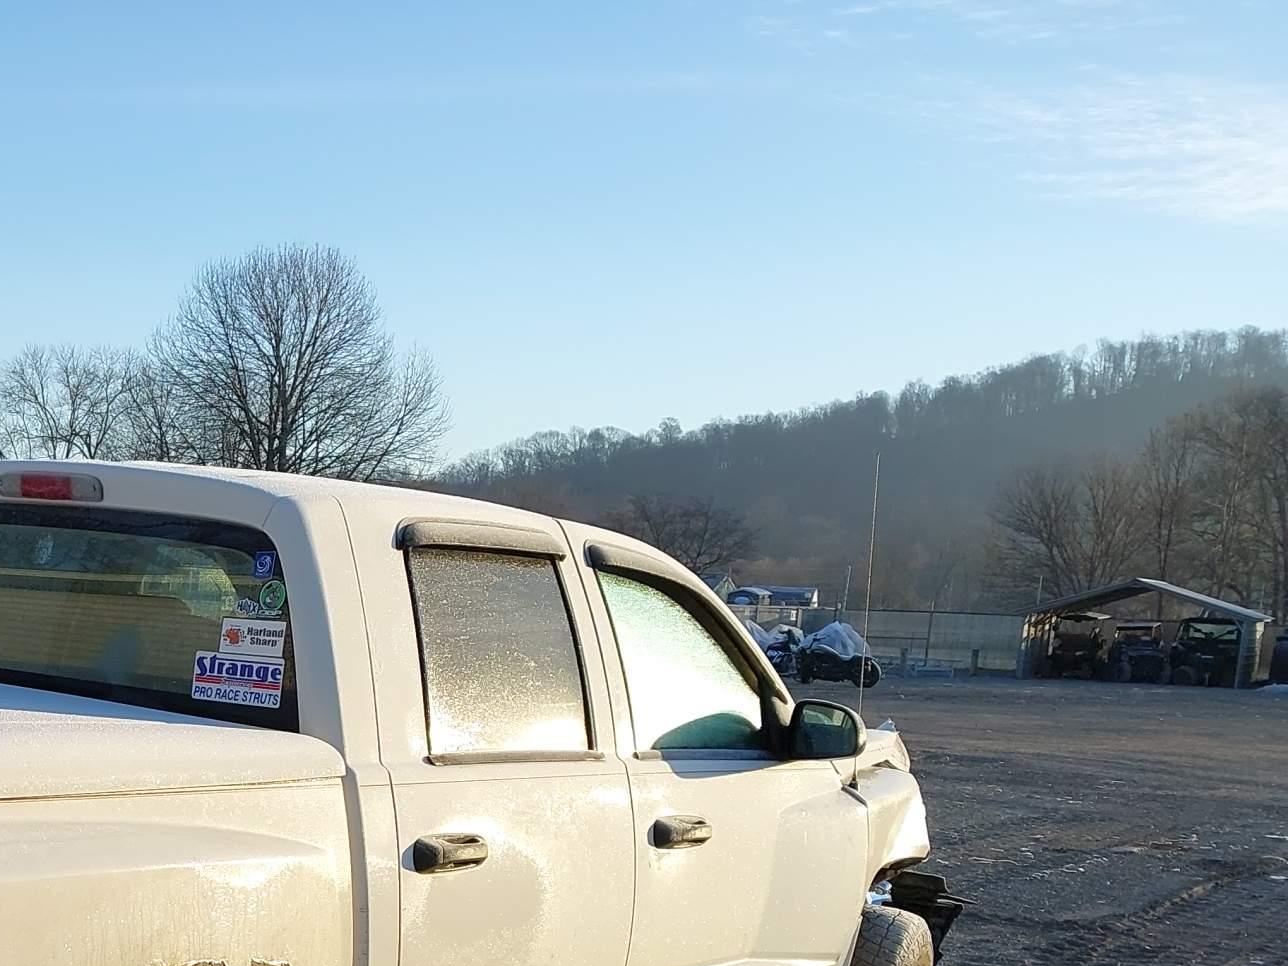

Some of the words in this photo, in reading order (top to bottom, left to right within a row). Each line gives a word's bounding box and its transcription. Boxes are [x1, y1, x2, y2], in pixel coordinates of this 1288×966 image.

[247, 626, 284, 638] Harland
[249, 637, 278, 648] Sharp
[196, 654, 282, 683] Strange
[193, 685, 214, 698] PRO
[215, 687, 241, 702] RACE
[241, 690, 280, 706] STRUTS
